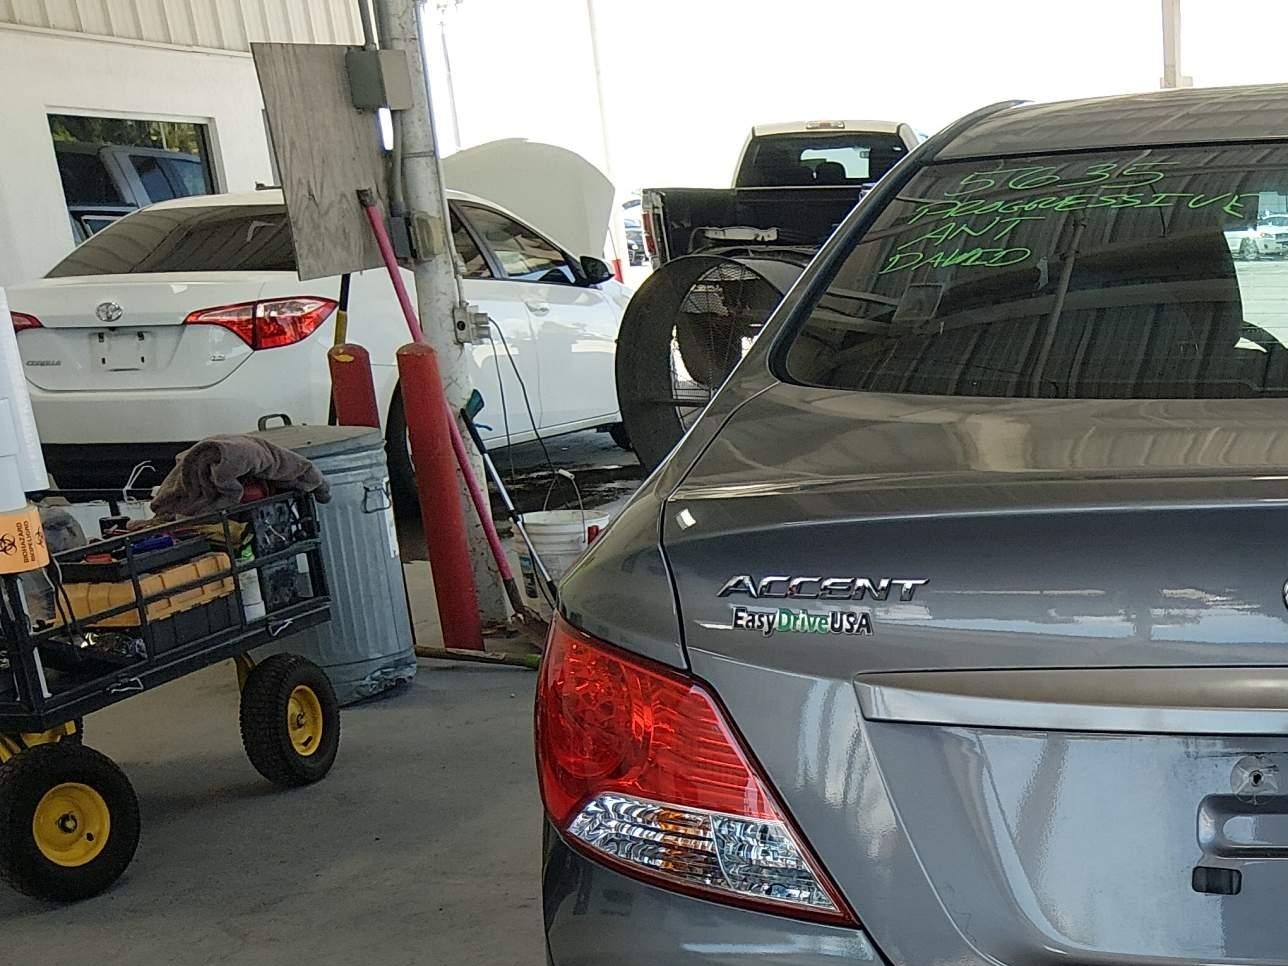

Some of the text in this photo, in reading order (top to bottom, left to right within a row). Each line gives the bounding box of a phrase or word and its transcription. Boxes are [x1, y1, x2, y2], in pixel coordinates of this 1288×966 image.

[945, 161, 1180, 197] 5635
[716, 575, 930, 602] ACCENT
[732, 606, 873, 636] EasyDriveUSA
